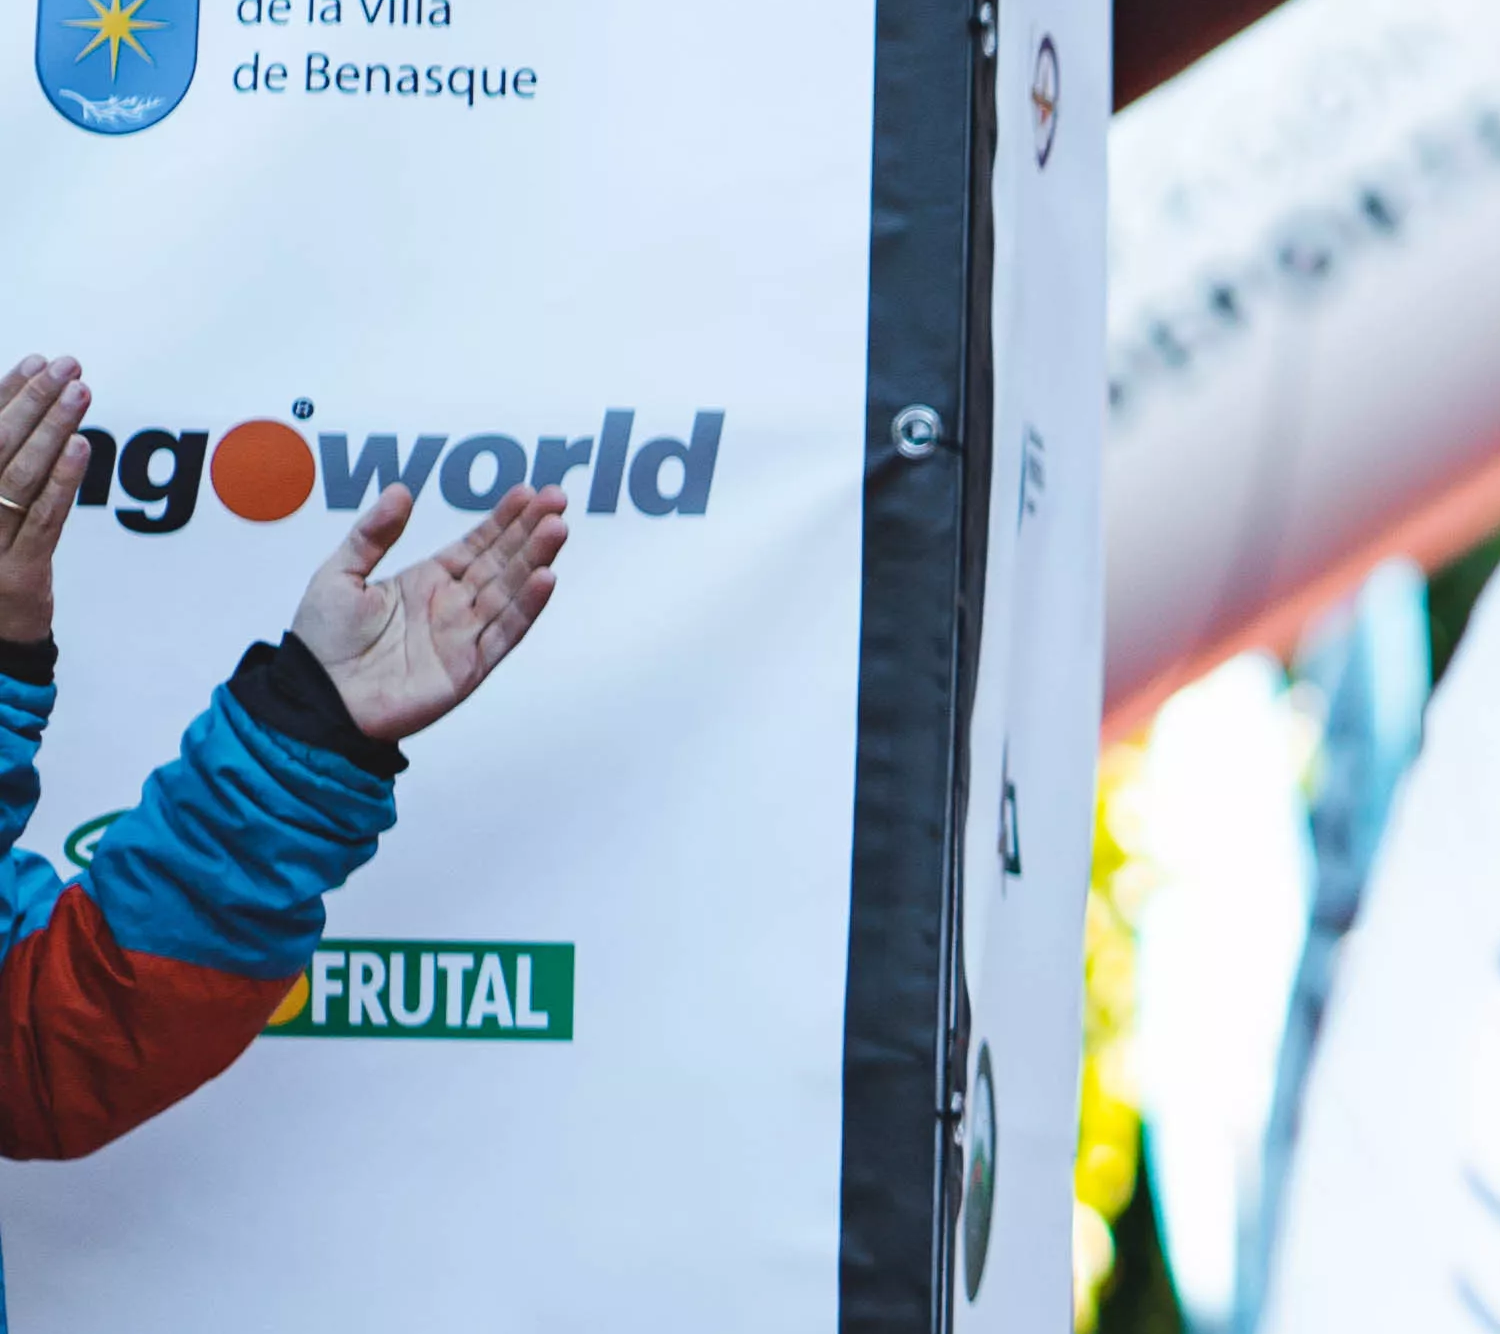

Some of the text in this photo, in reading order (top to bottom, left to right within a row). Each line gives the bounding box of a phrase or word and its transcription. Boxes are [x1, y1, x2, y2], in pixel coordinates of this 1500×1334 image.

[231, 53, 539, 108] de Benasque
[310, 950, 549, 1030] FRUTAL
